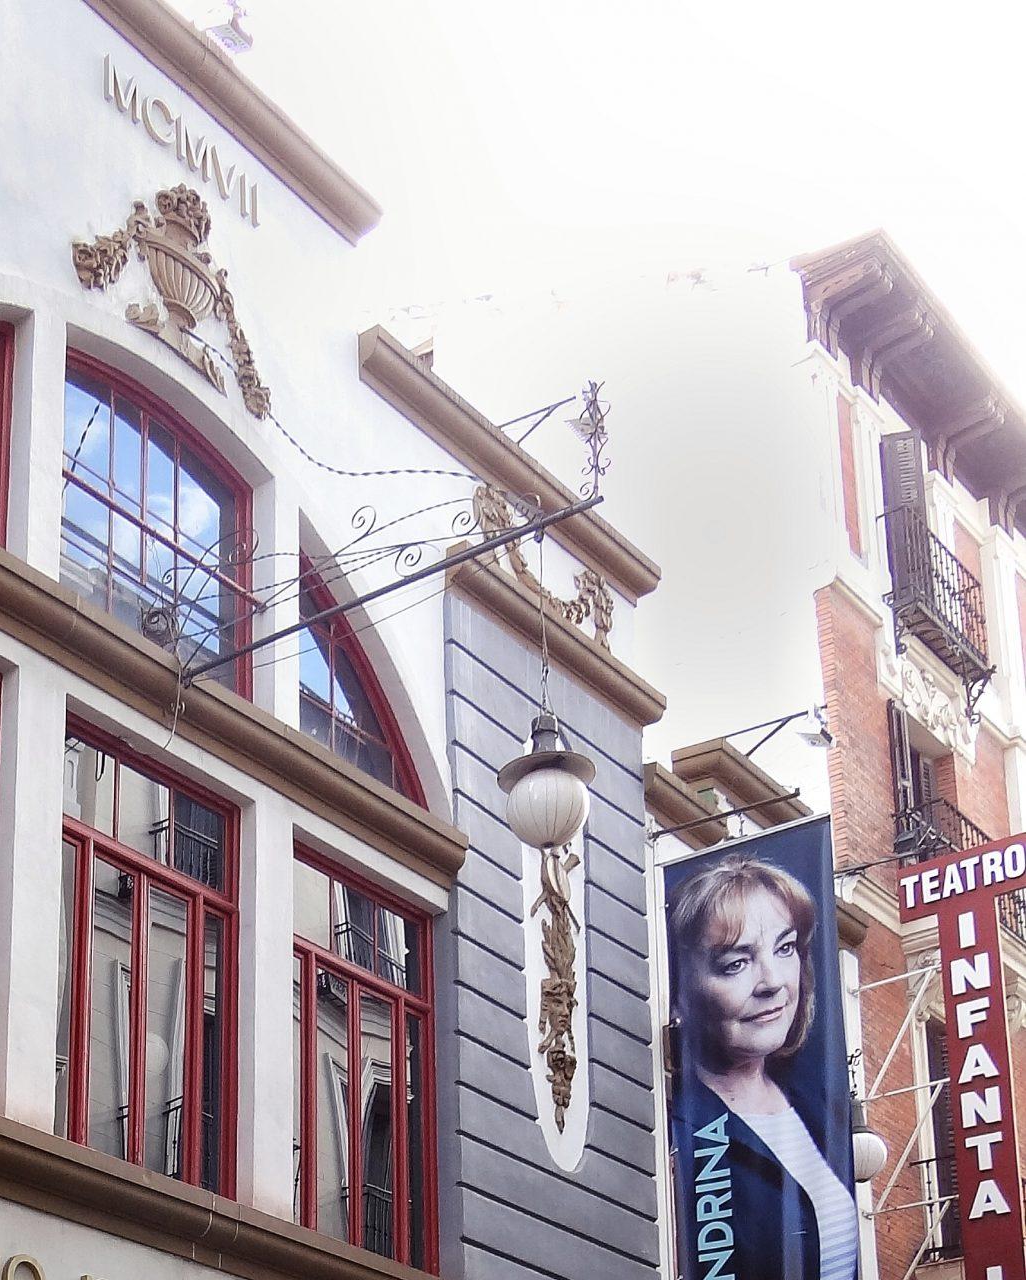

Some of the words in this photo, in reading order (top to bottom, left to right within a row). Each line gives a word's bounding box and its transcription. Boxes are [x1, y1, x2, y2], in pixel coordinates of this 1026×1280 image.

[103, 53, 261, 229] MCMVII
[899, 843, 1026, 910] TEATRO
[949, 910, 1012, 1220] INFANTA
